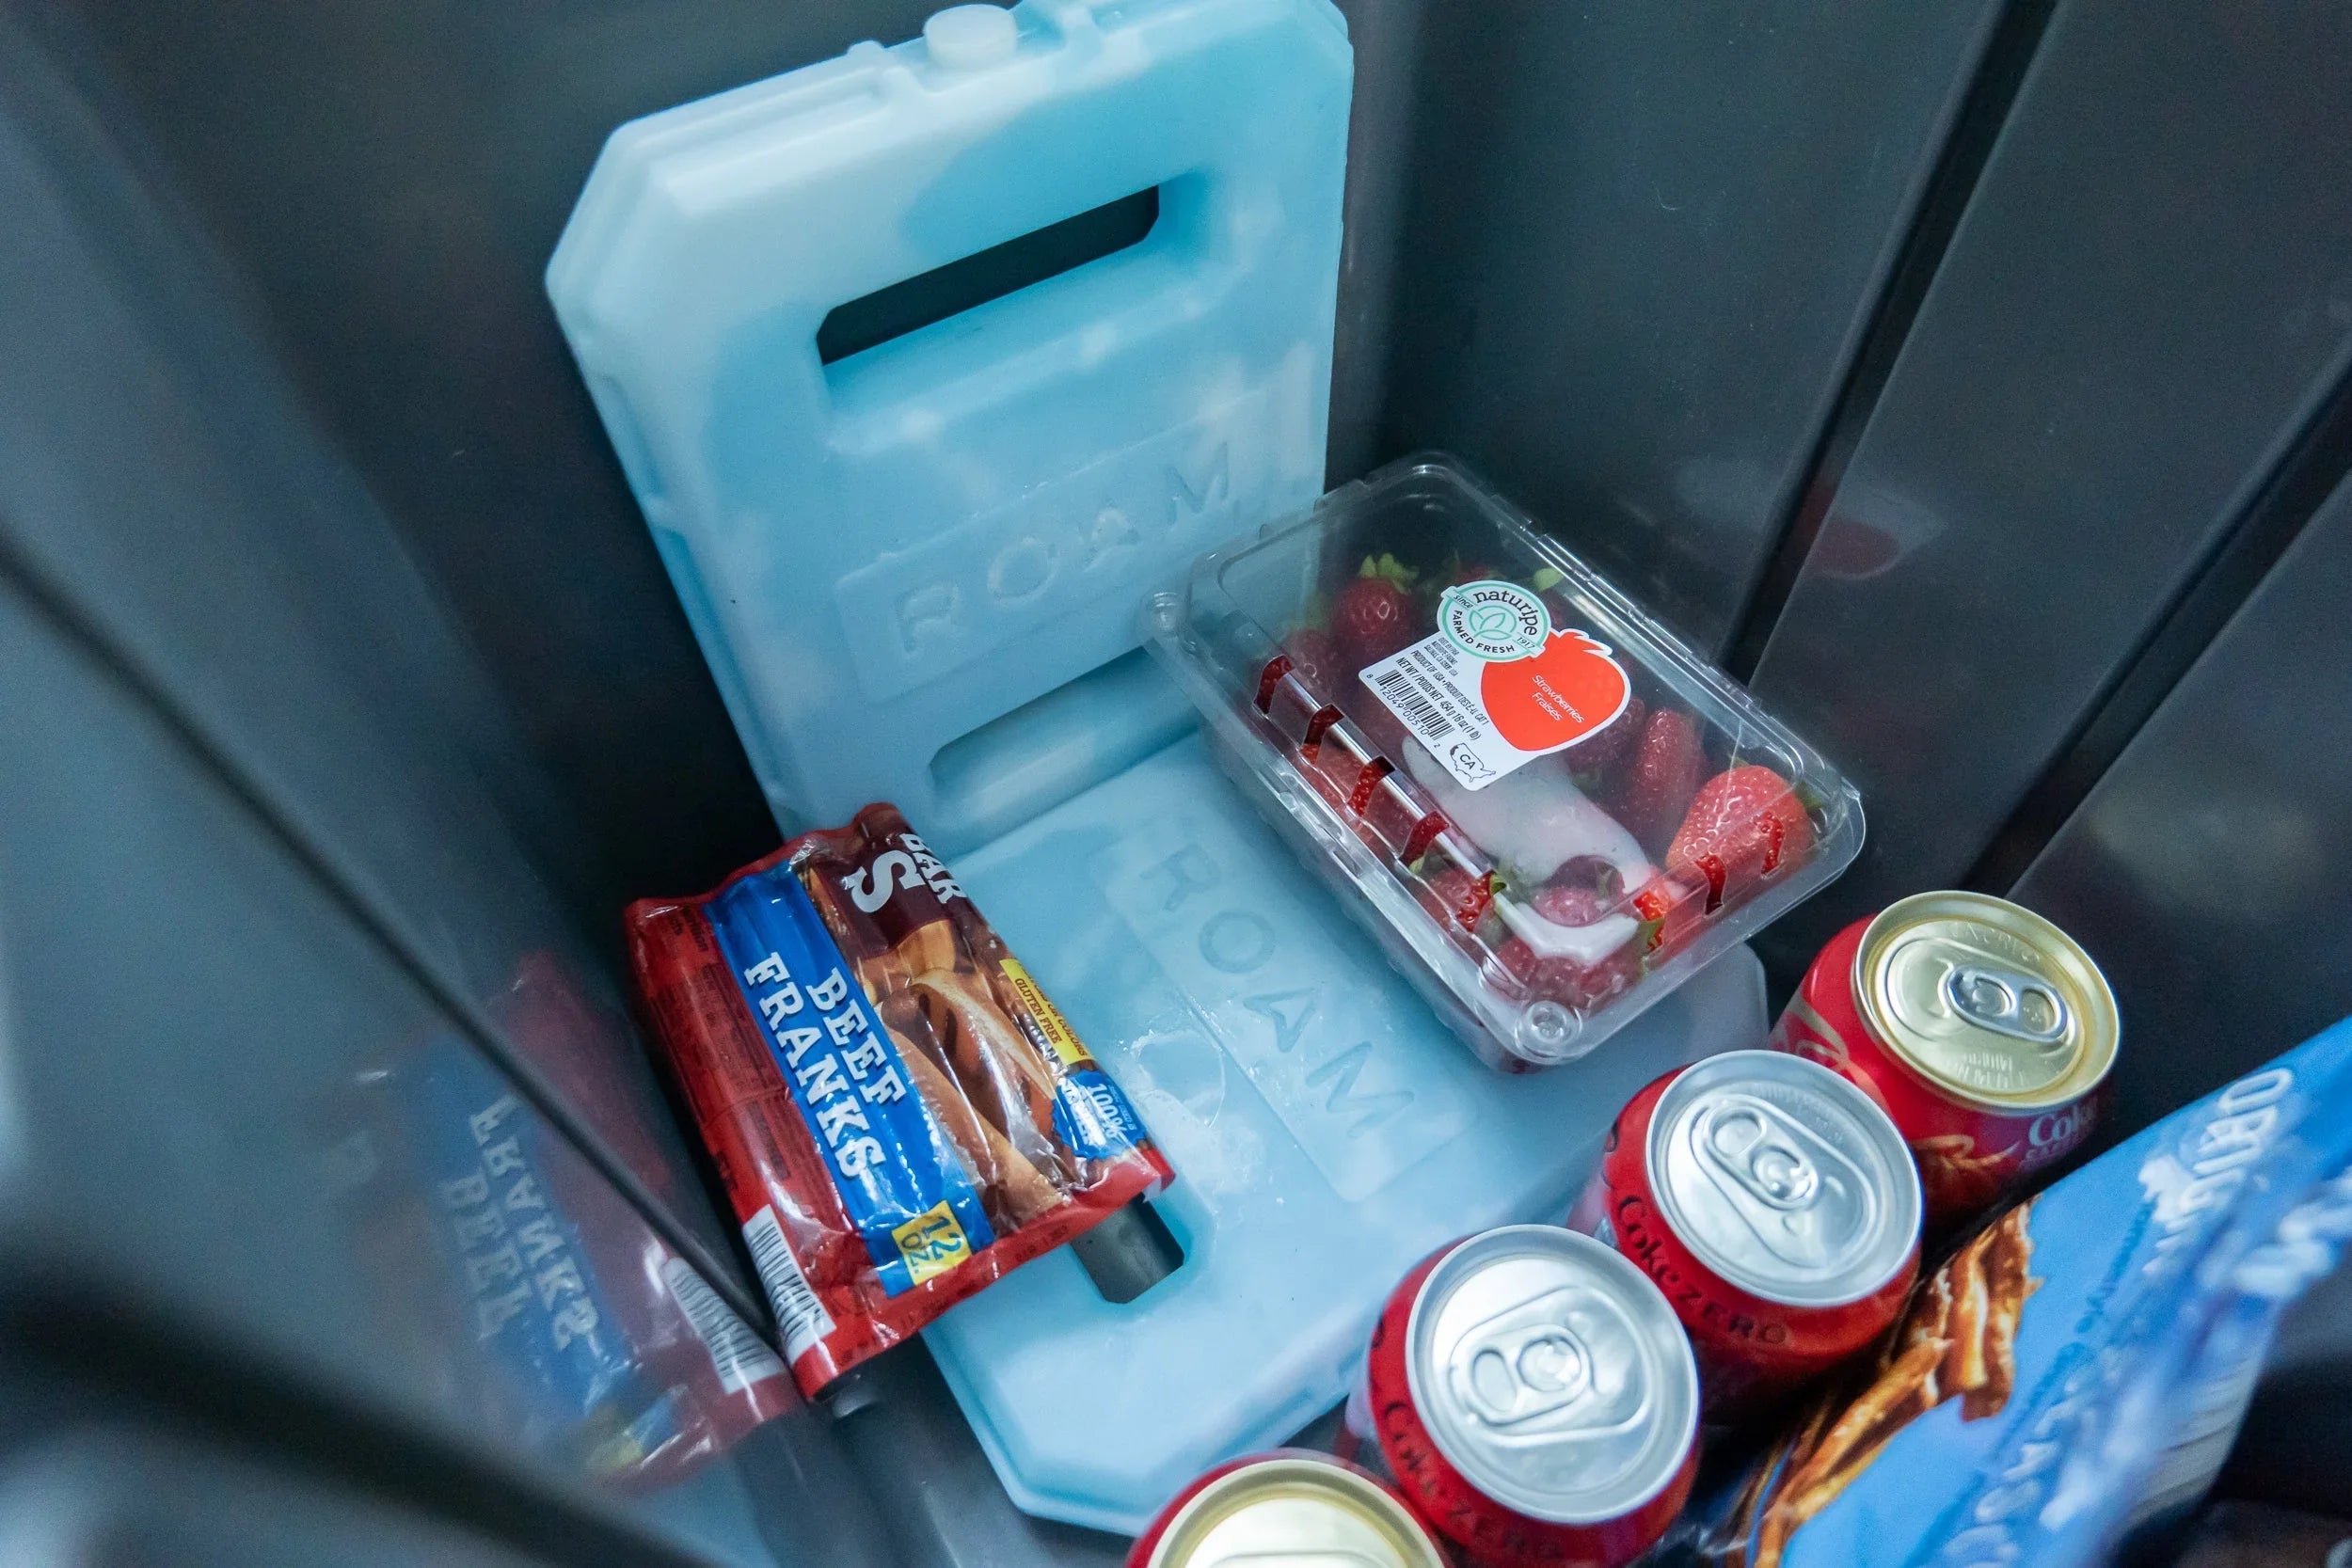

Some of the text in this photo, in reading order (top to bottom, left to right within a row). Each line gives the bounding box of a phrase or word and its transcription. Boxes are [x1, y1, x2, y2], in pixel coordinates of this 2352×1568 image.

[895, 440, 1230, 653] ROAM
[1454, 594, 1473, 609] since
[1472, 590, 1538, 636] naturipe
[1453, 610, 1516, 654] FARMED FRESH
[1517, 637, 1535, 649] 1917
[1396, 657, 1412, 668] NET
[1406, 666, 1419, 675] WT
[1415, 675, 1436, 692] POIDS
[1429, 689, 1445, 702] NET
[1439, 701, 1454, 711] 454
[1453, 713, 1465, 722] 16
[1411, 650, 1432, 668] PRODUCT
[1433, 672, 1445, 681] USA
[1379, 686, 1405, 708] 12049
[1402, 710, 1430, 736] 00510
[1532, 674, 1585, 723] Strawberries
[1532, 691, 1563, 721] Fraises
[1459, 753, 1477, 769] CA
[841, 849, 927, 913] S
[1014, 977, 1047, 1018] GLUTEN
[1039, 1013, 1063, 1044] FREE
[1136, 843, 1415, 1139] ROAM
[805, 967, 907, 1106] BEEF
[743, 951, 886, 1178] FRANKS
[1087, 1083, 1129, 1138] 100%
[901, 1232, 930, 1274] OZ.
[921, 1215, 964, 1260] 12
[1617, 1195, 1787, 1345] Coke ZERO
